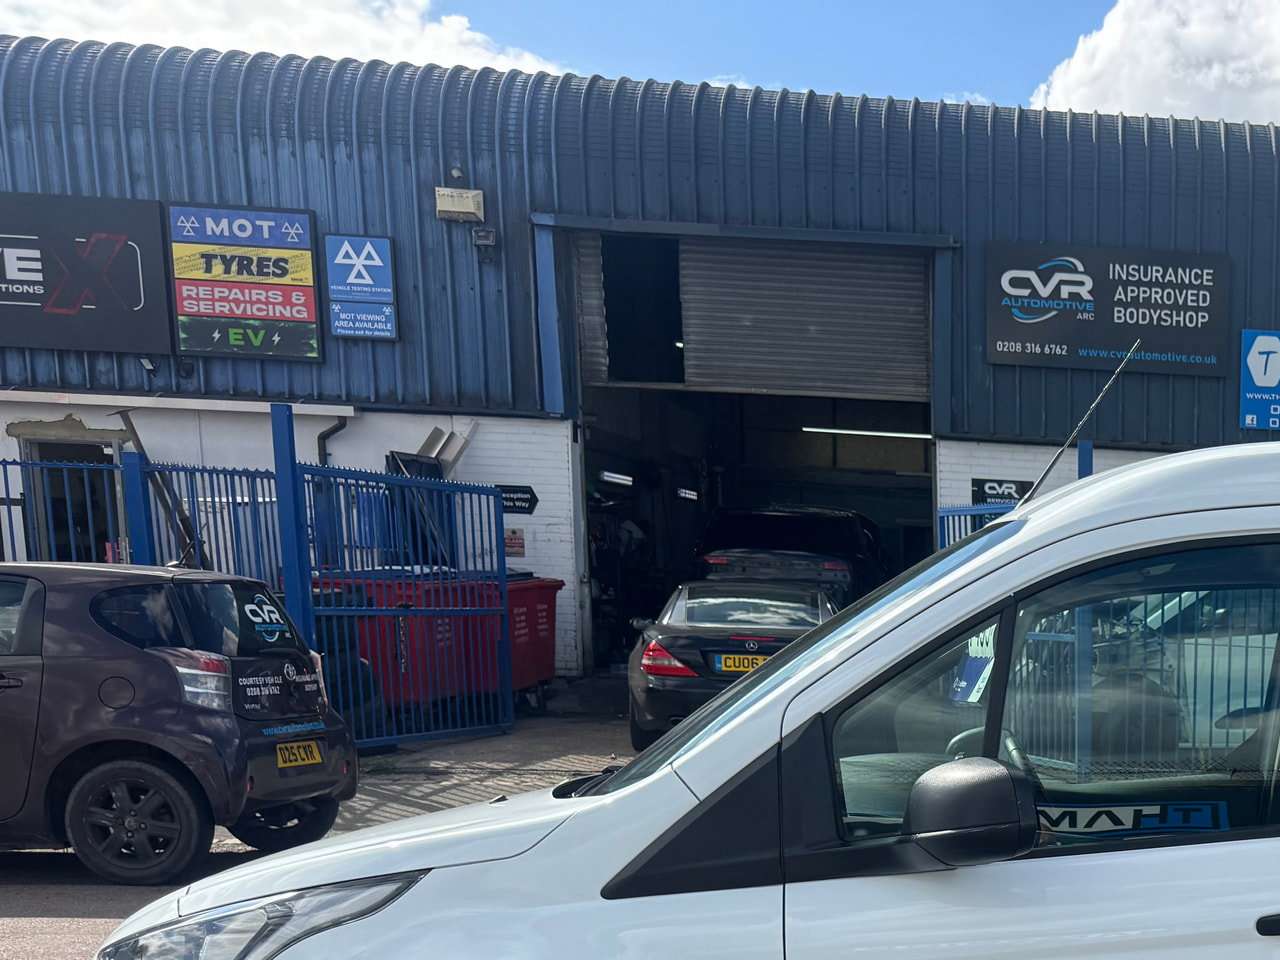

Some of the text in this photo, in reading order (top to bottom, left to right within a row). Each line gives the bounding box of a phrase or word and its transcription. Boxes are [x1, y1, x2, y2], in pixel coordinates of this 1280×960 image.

[205, 217, 276, 239] MOT
[0, 247, 43, 281] E
[200, 253, 289, 278] TYRES
[1109, 263, 1214, 286] INSURANCE
[1001, 269, 1094, 300] CVR
[182, 286, 306, 304] REPAIRS &
[1001, 297, 1096, 311] AUTOMOTIVE
[1114, 286, 1210, 307] APPROVED
[183, 300, 308, 319] SERVICING
[356, 313, 386, 322] VIEWING
[1076, 312, 1095, 321] ARC
[1113, 308, 1210, 328] BODYSHOP
[334, 320, 392, 330] AREA AVAILABLE
[228, 328, 266, 347] EV
[996, 341, 1068, 355] 0208 316 6762
[1258, 350, 1278, 376] T
[984, 482, 1020, 498] CVR
[245, 604, 284, 623] CVR
[724, 656, 760, 669] CU06
